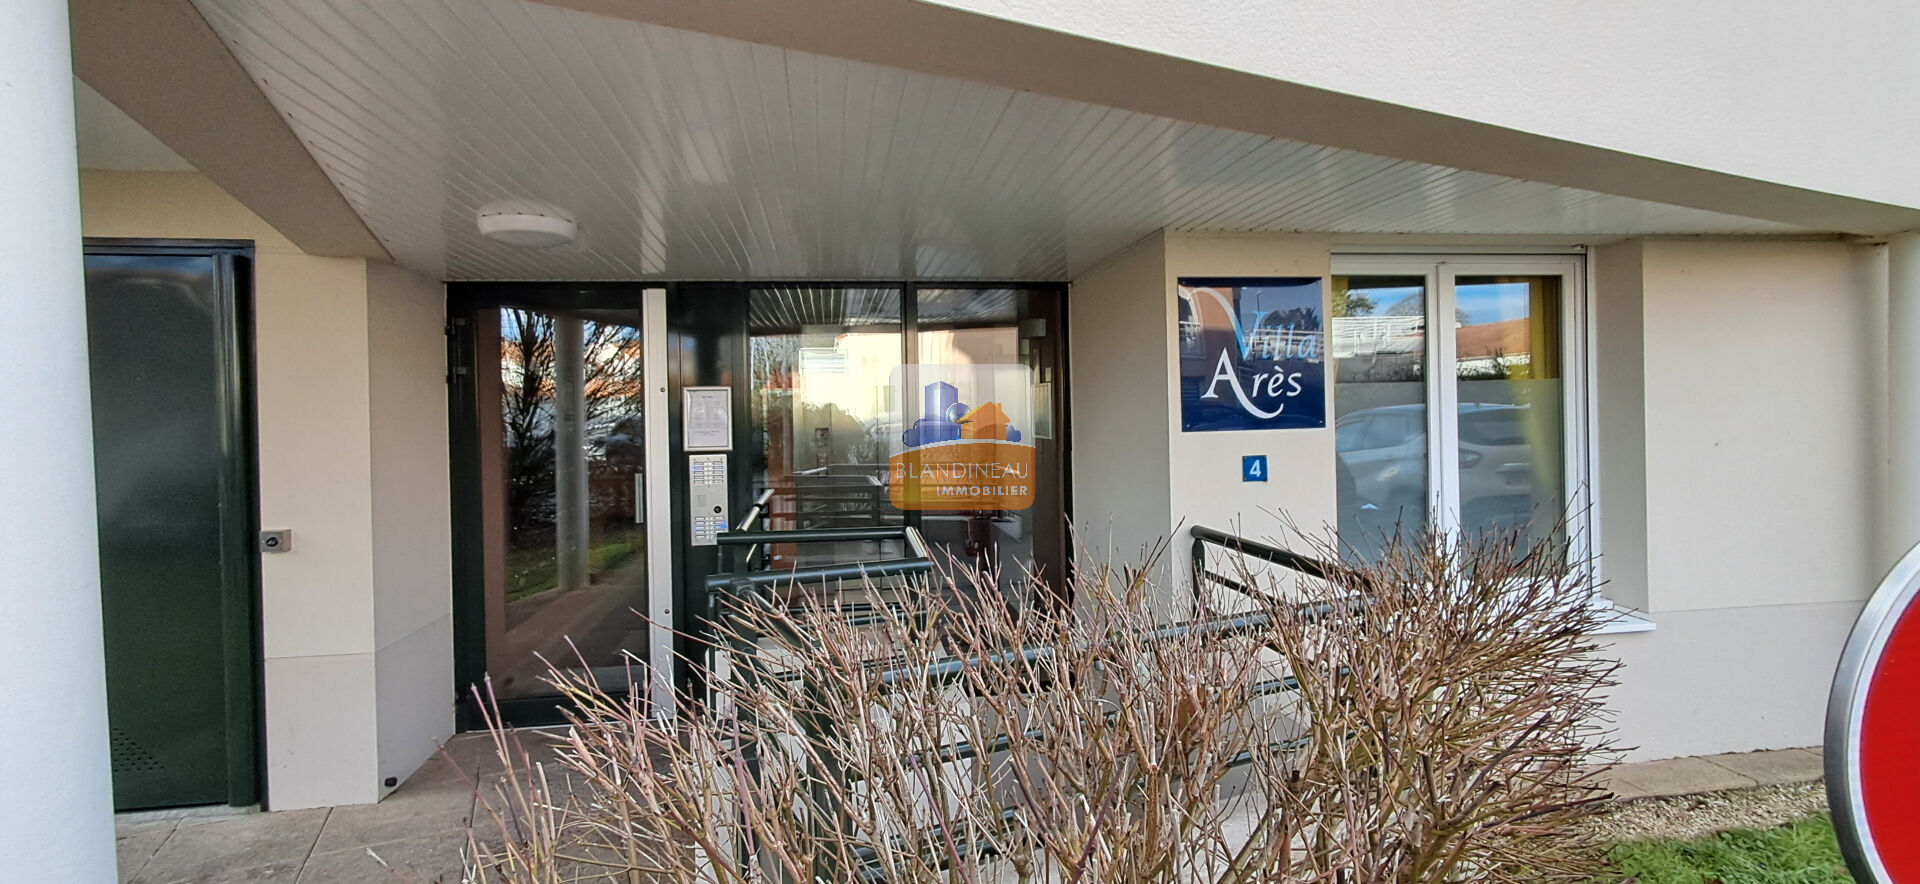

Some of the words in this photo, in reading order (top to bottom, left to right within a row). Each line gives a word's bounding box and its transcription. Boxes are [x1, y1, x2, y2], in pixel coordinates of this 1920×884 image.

[1190, 287, 1317, 361] Villa
[1201, 347, 1302, 419] Arès
[1249, 459, 1262, 477] 4
